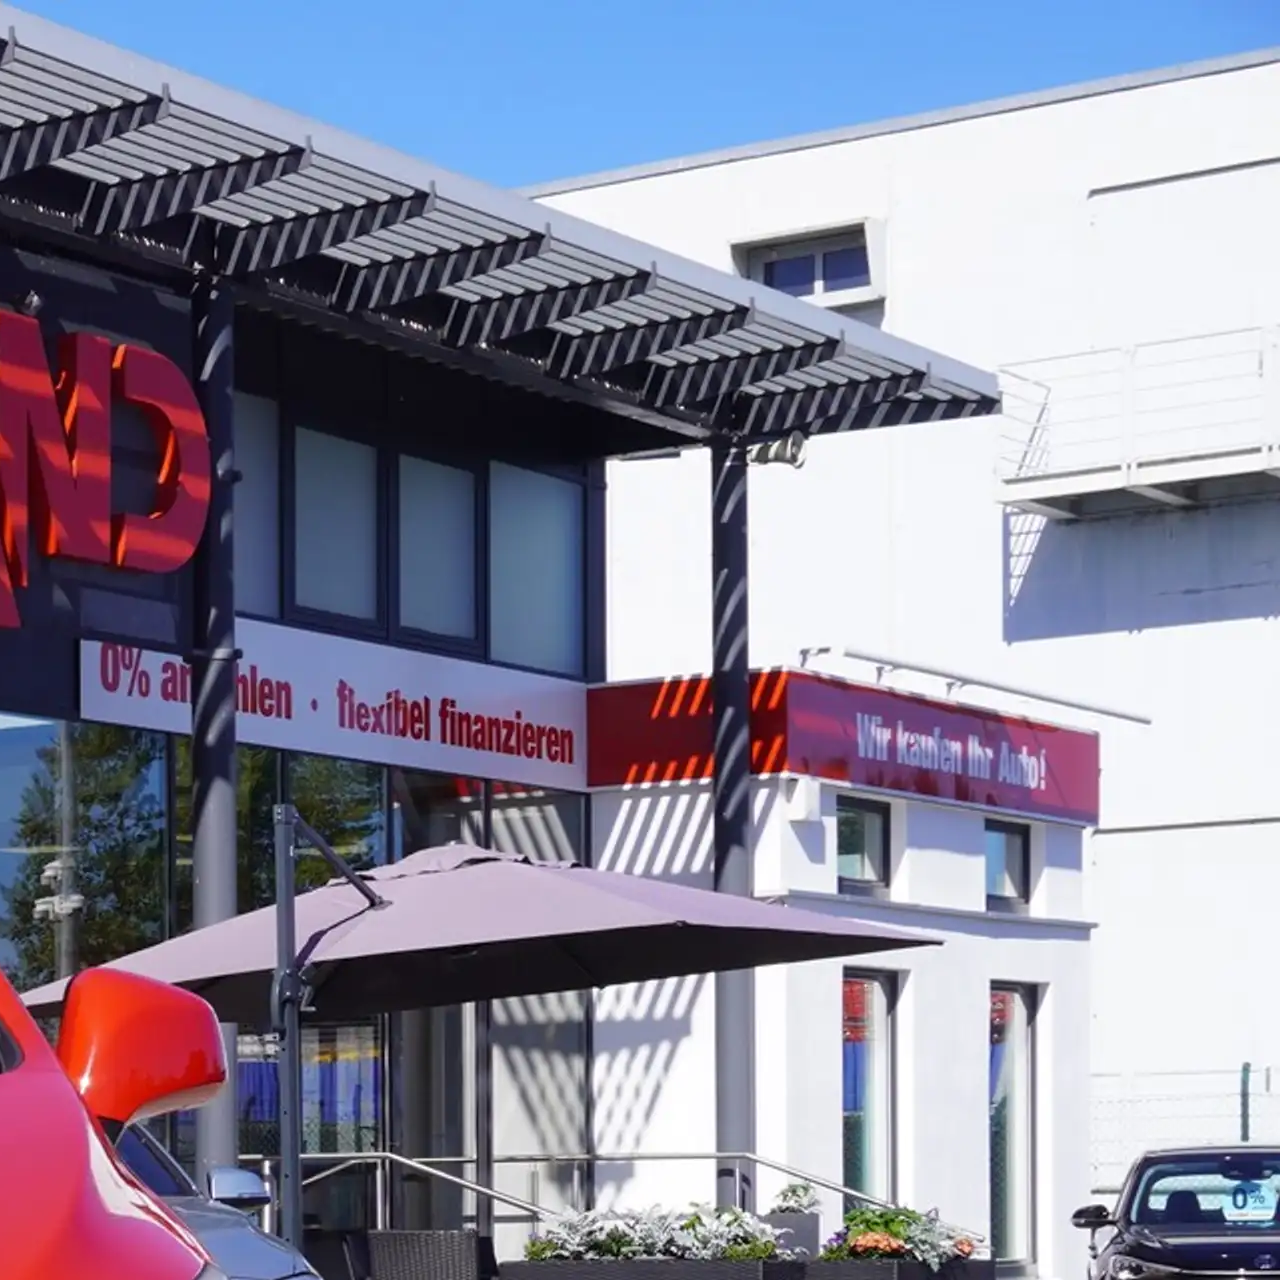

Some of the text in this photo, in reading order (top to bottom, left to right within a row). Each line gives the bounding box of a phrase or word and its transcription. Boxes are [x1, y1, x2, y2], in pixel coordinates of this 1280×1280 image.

[100, 641, 573, 764] 0% anhlen flexibel finanzieren
[856, 712, 1047, 791] Wir kaufen Ihr Auto!
